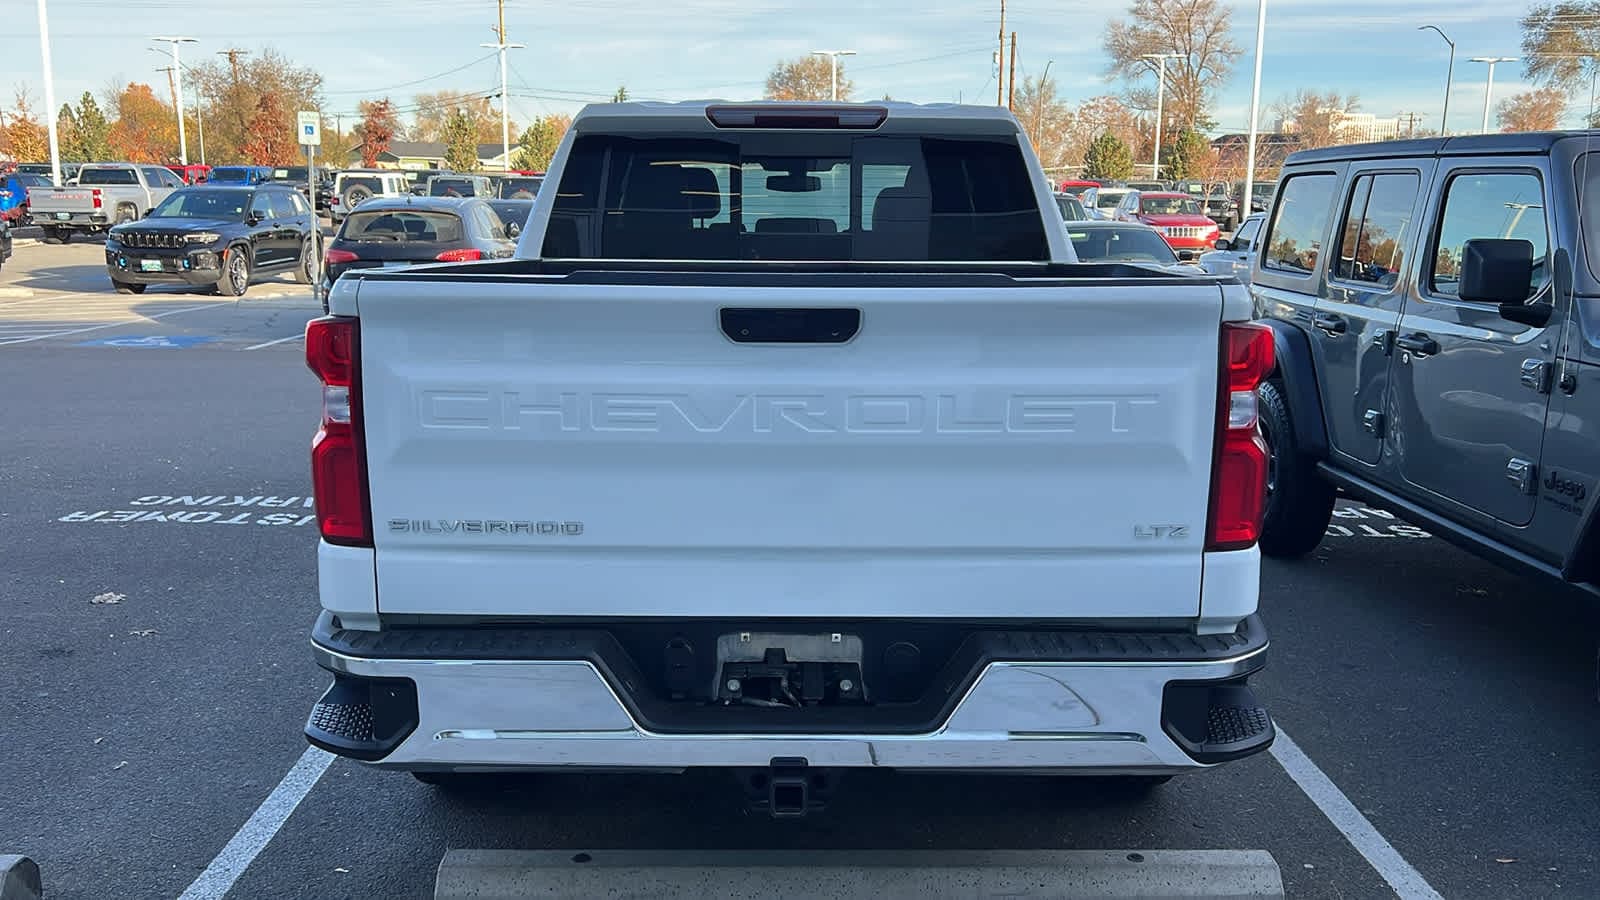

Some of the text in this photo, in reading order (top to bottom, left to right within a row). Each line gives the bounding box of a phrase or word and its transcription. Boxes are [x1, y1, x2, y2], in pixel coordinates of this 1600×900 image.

[419, 390, 1160, 433] CHEVROLET
[1544, 472, 1586, 502] Jeep
[388, 519, 585, 536] SILVERADO
[1134, 524, 1188, 537] LTZ
